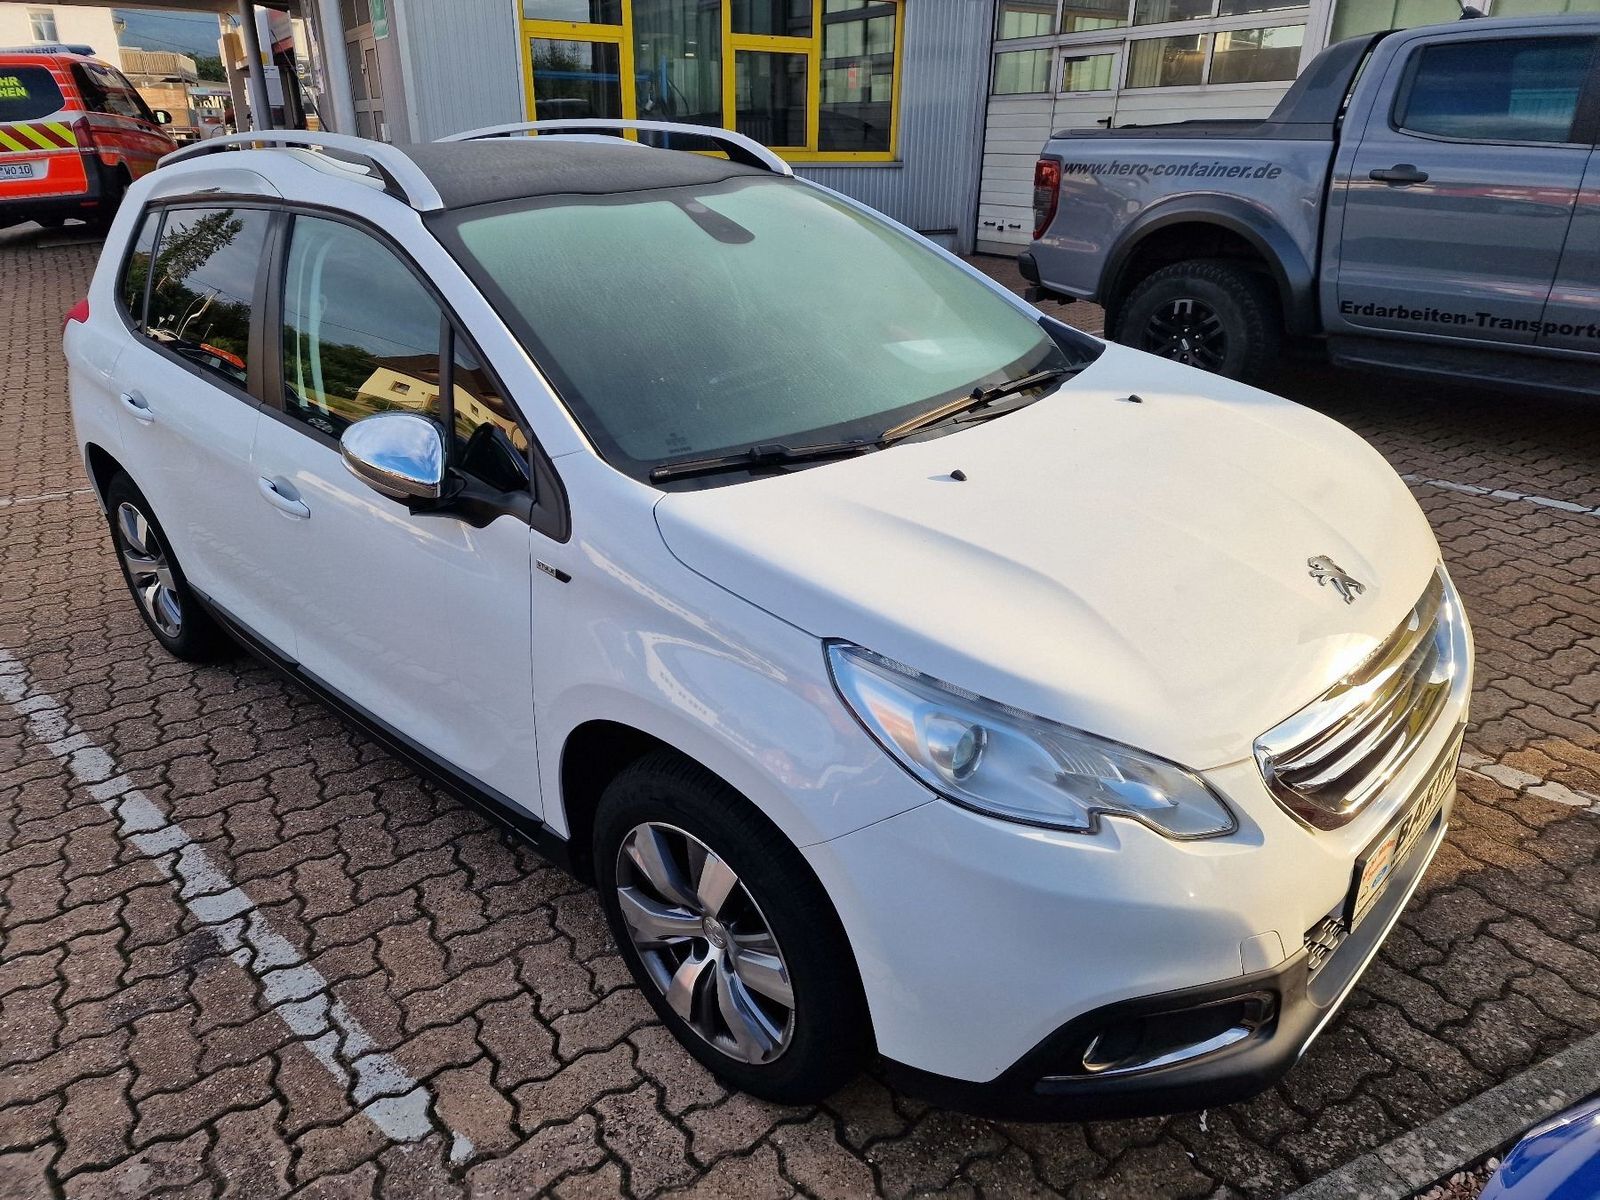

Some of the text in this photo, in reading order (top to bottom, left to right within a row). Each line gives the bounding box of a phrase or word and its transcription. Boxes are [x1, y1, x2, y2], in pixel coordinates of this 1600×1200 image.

[4, 165, 30, 175] WO 10
[1064, 160, 1282, 179] www.hero-container.de
[1340, 300, 1600, 338] Erdarbeiten-Transport
